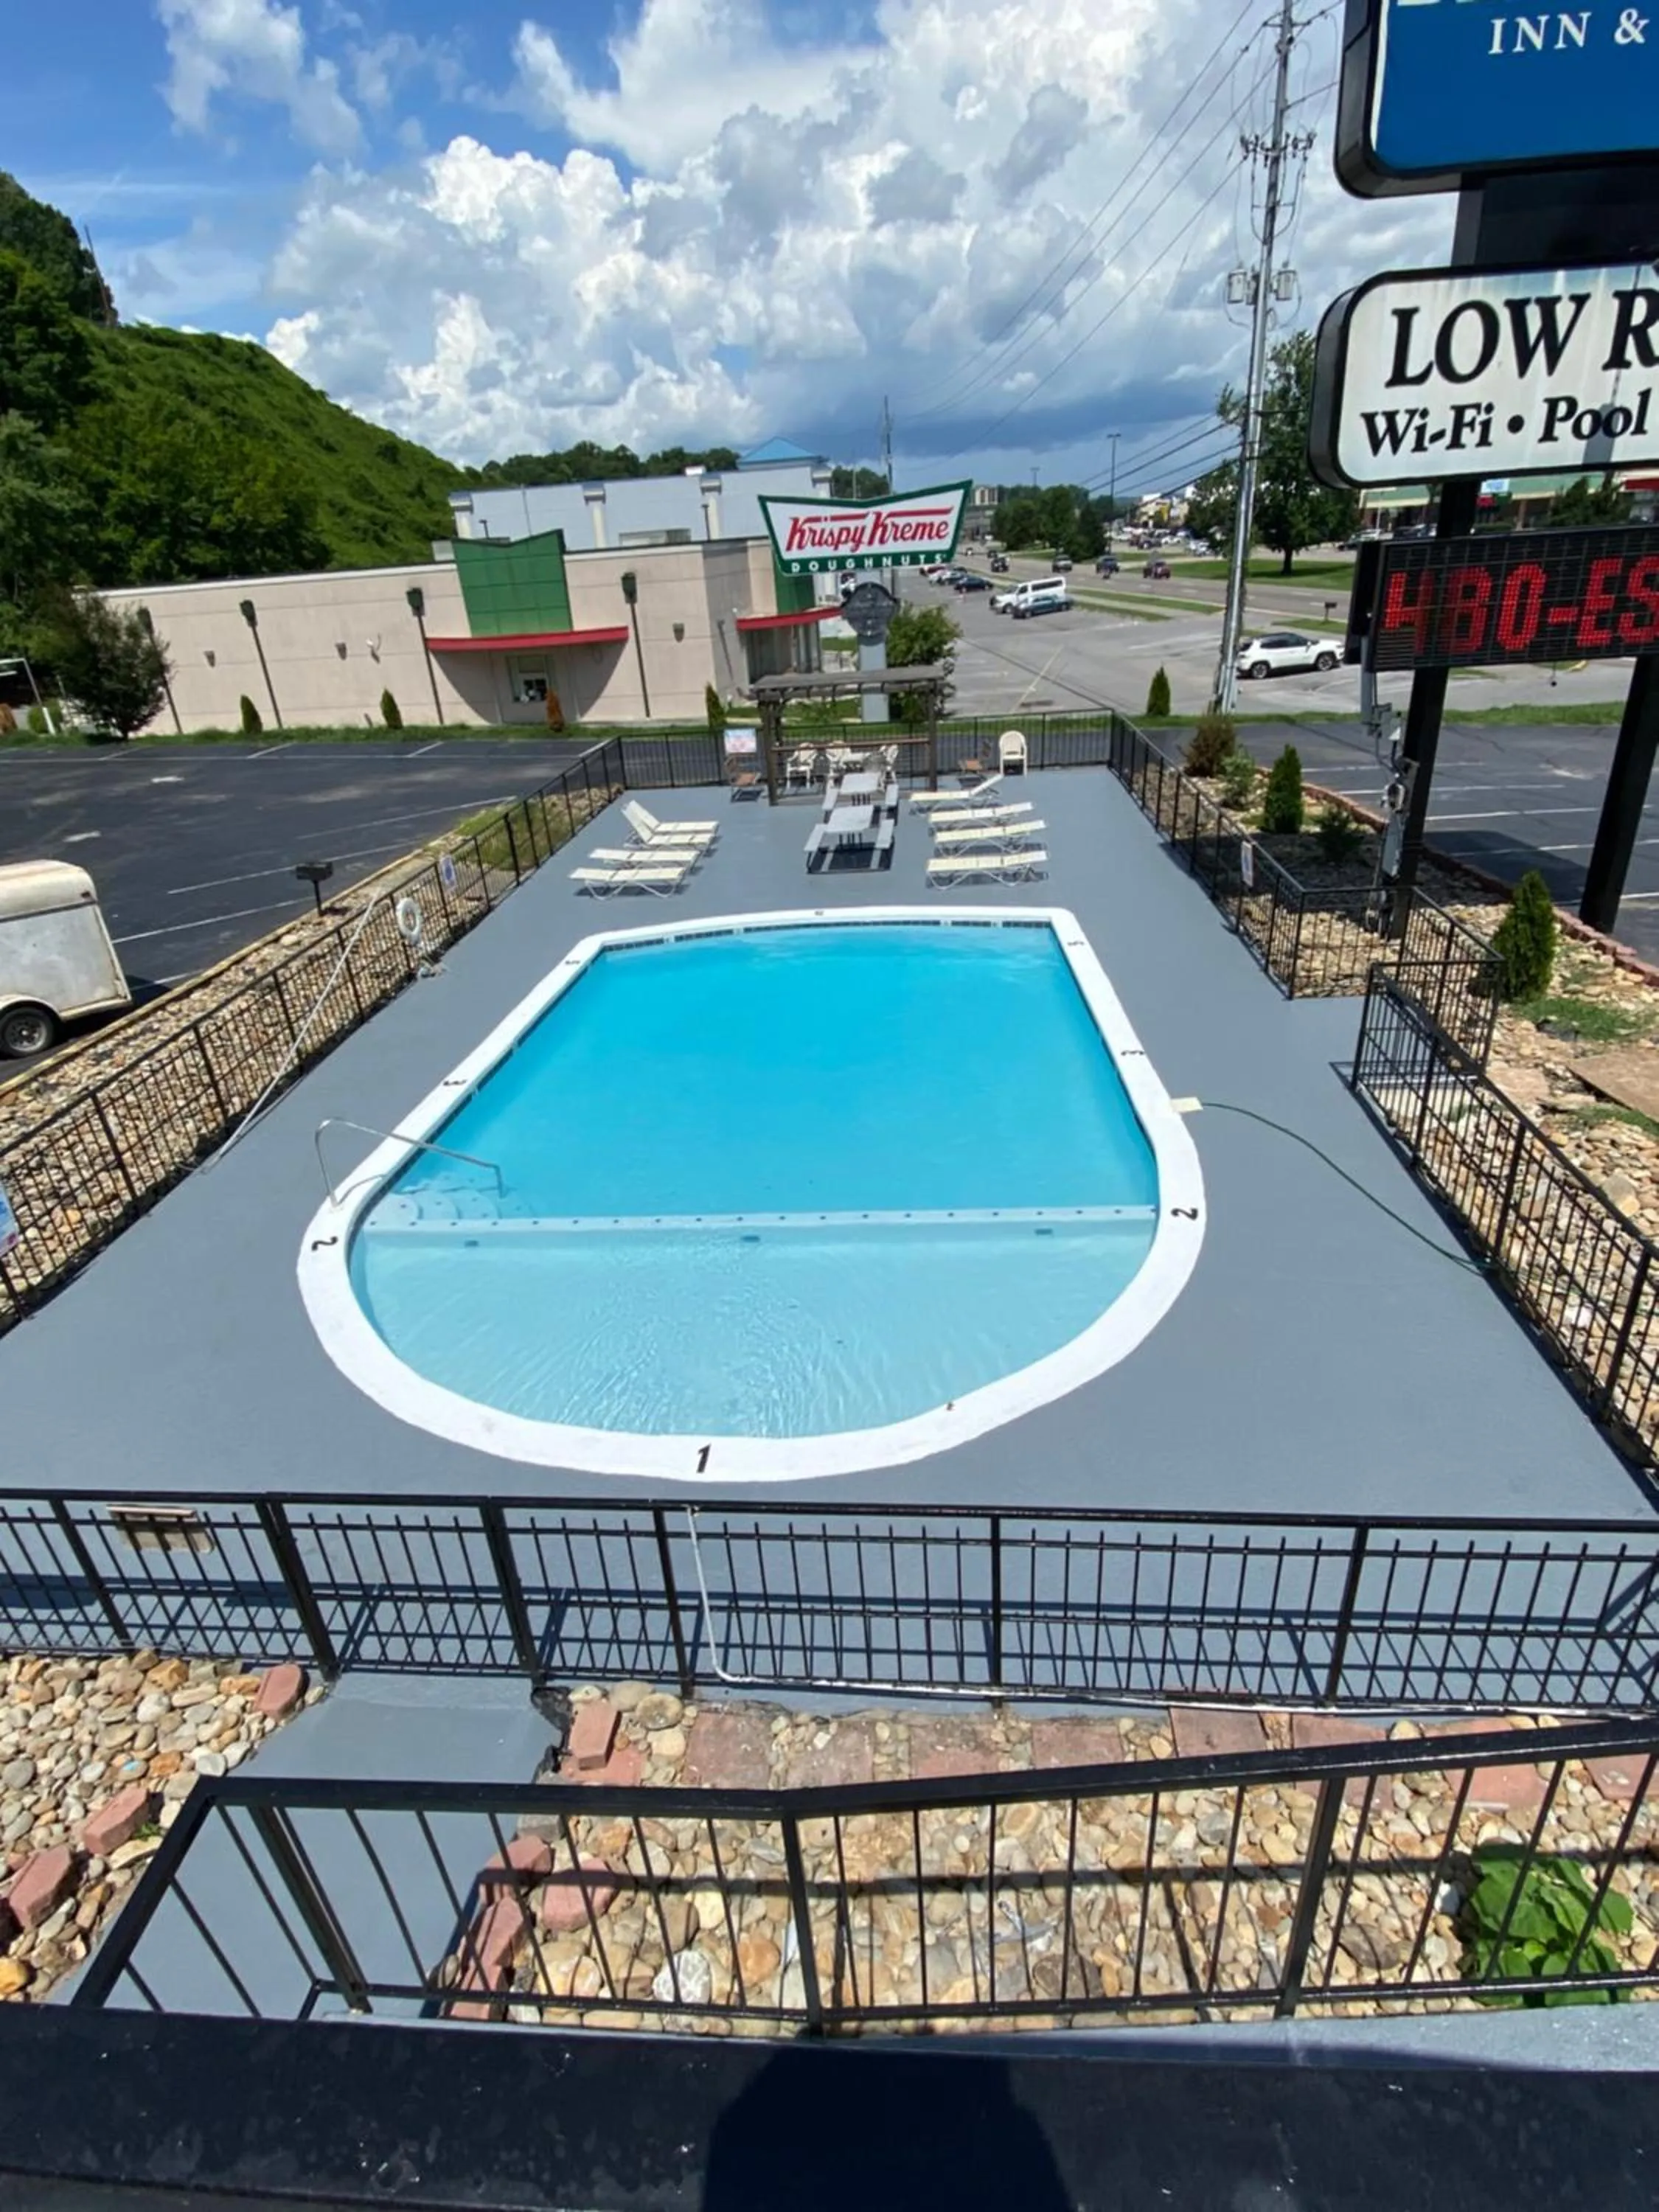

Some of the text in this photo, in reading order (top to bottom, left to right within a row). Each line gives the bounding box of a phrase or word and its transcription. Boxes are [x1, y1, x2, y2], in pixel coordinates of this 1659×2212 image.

[1488, 8, 1649, 55] INN &
[1385, 292, 1591, 388] LOW
[1360, 387, 1652, 457] Wi-Fi Pool
[786, 507, 954, 553] Krispy Kreme
[791, 554, 947, 574] DOUGHNUTS
[1170, 1207, 1198, 1221] 2
[696, 1442, 712, 1474] 1
